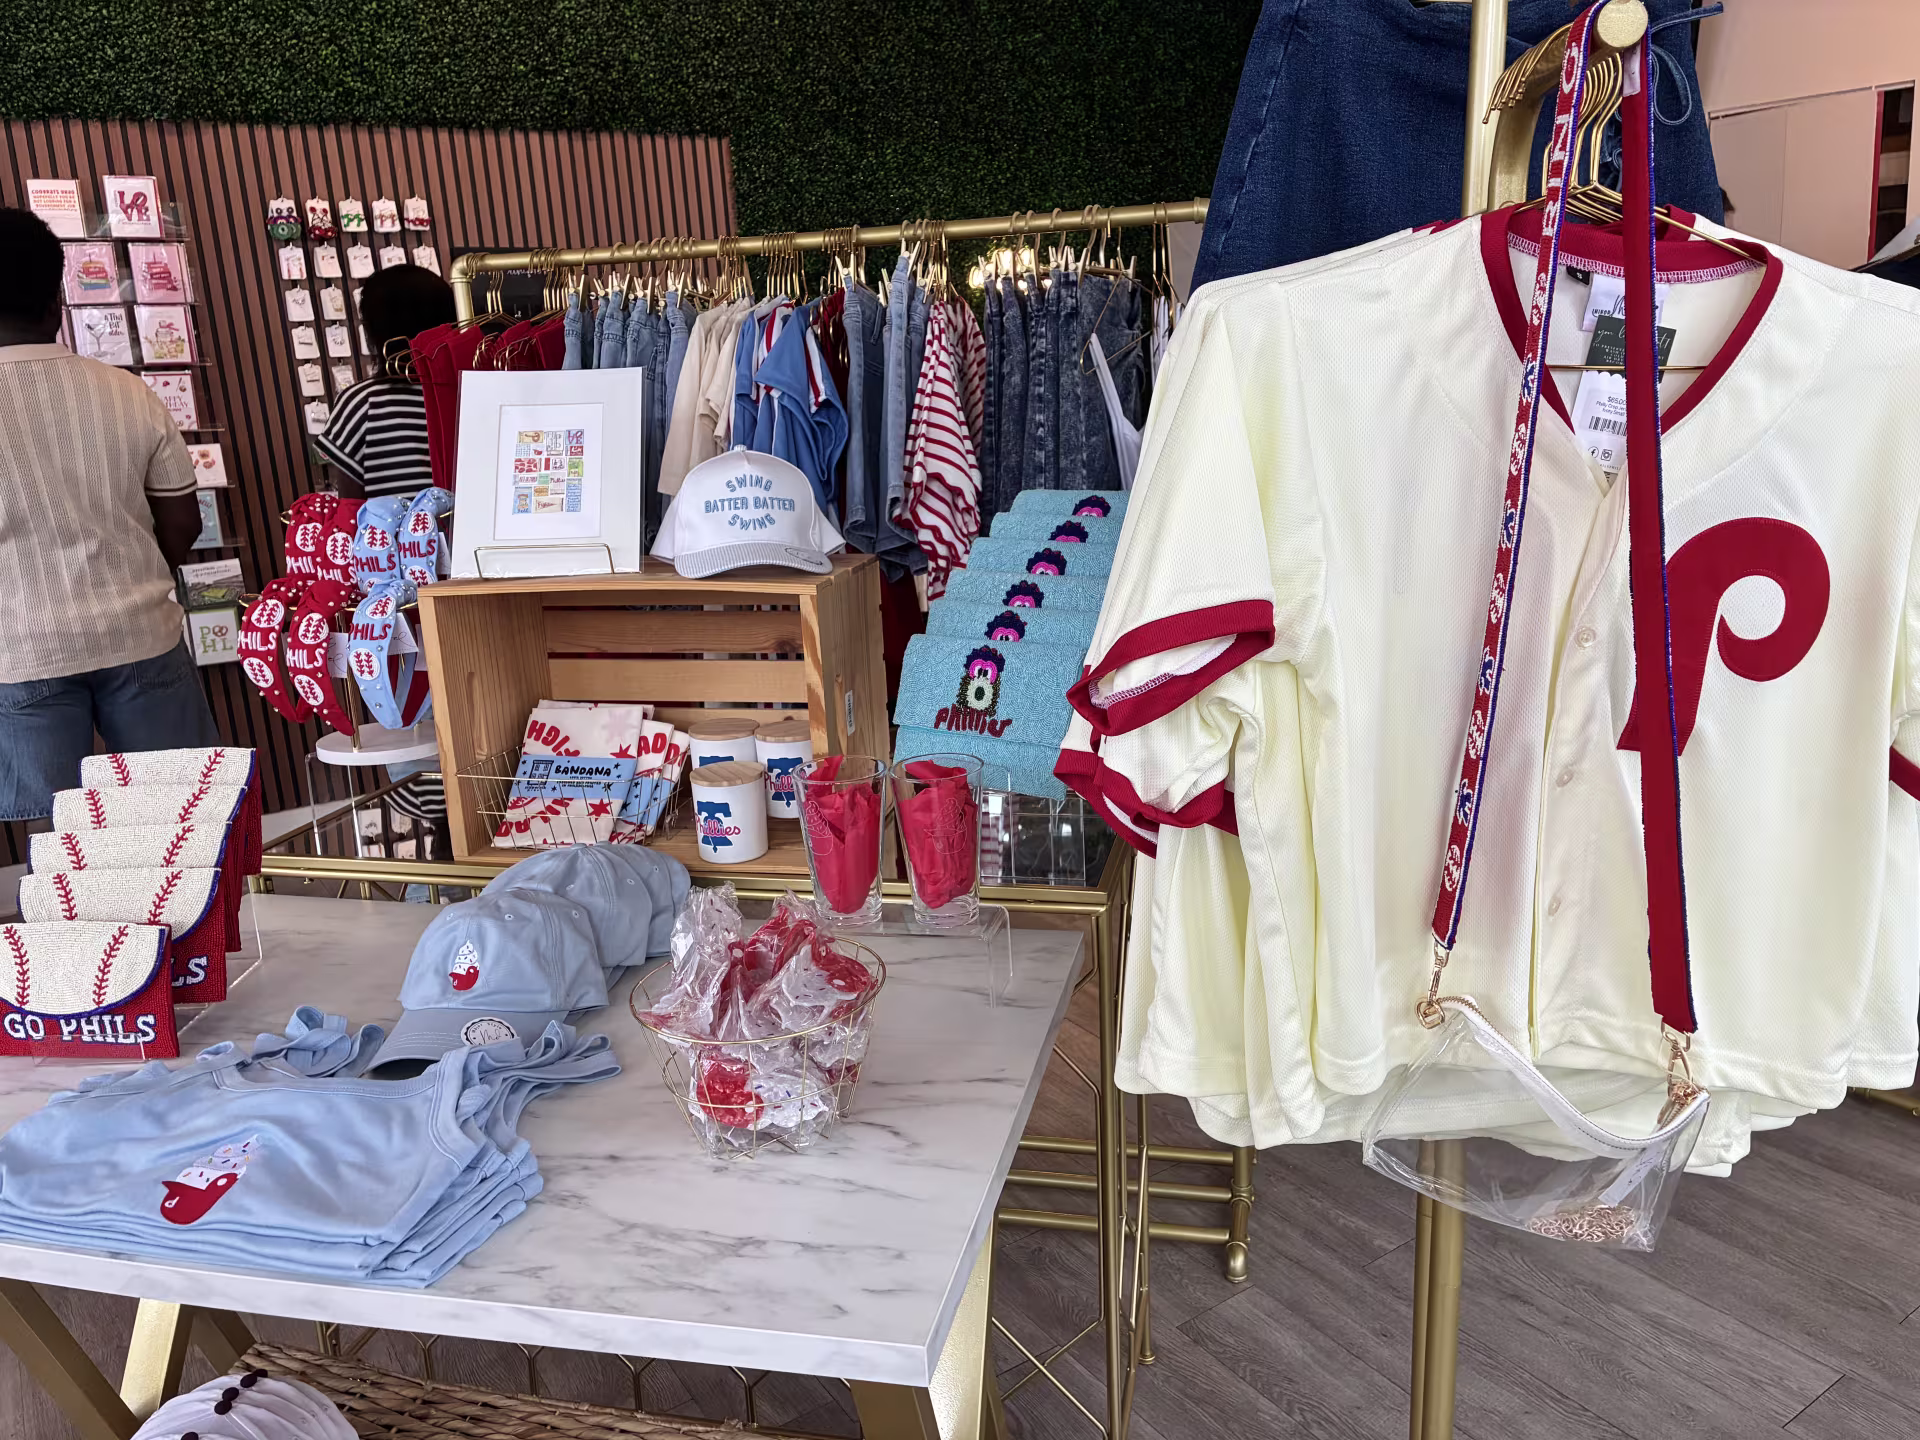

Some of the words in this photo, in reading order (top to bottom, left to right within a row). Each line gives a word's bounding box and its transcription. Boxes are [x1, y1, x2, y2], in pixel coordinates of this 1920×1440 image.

[725, 474, 773, 493] SWING
[704, 496, 748, 514] BATTER
[753, 496, 796, 512] BATTER
[728, 513, 776, 531] SWING
[554, 765, 612, 777] BANDANA
[4, 1013, 45, 1040] GO
[60, 1014, 156, 1043] PHILS
